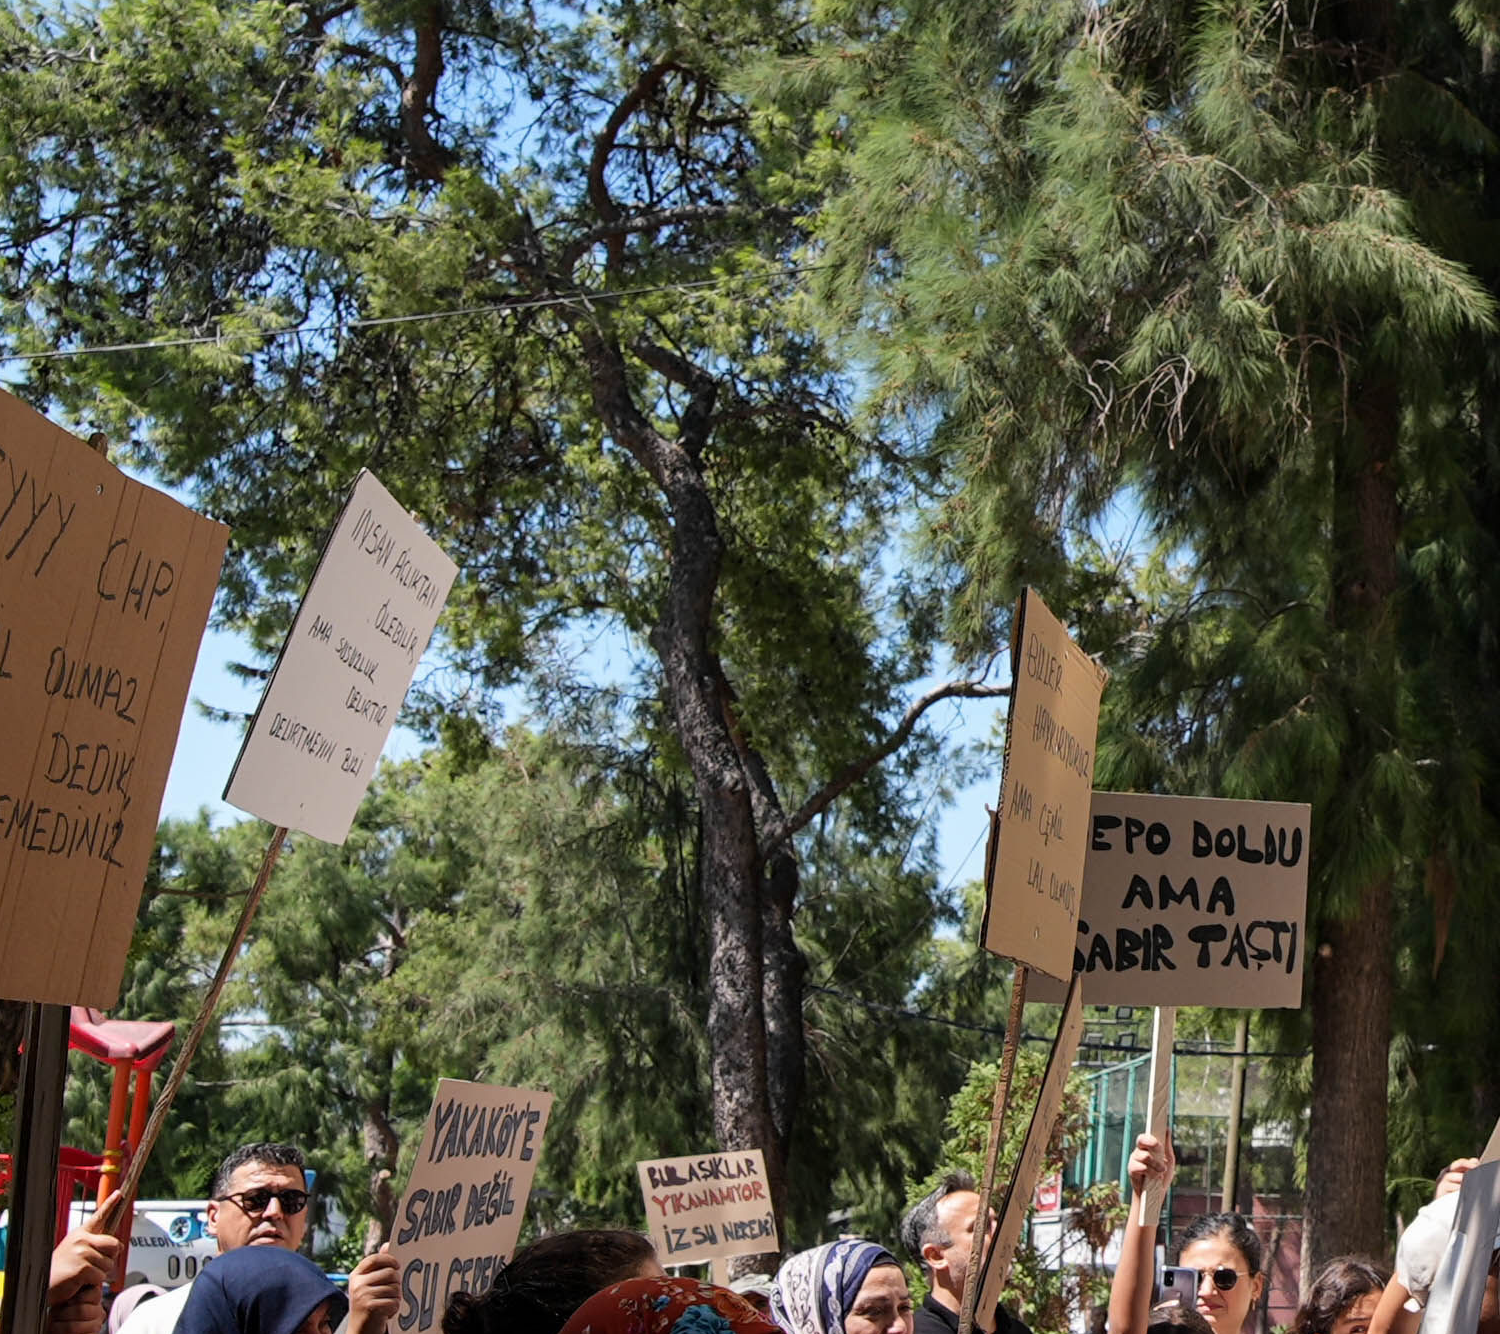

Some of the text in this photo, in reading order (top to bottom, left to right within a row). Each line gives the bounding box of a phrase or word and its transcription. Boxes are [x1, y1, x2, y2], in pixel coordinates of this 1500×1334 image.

[308, 614, 333, 643] AMA
[1008, 779, 1033, 822] AMA
[1092, 815, 1302, 867] EPO DOLDU
[1121, 874, 1236, 916] AMA
[1188, 920, 1297, 974] TAŞTI
[428, 1098, 541, 1164] YAKAKÖY'E
[397, 1169, 515, 1246] SABIR DEĞİL
[398, 1258, 439, 1332] SU
